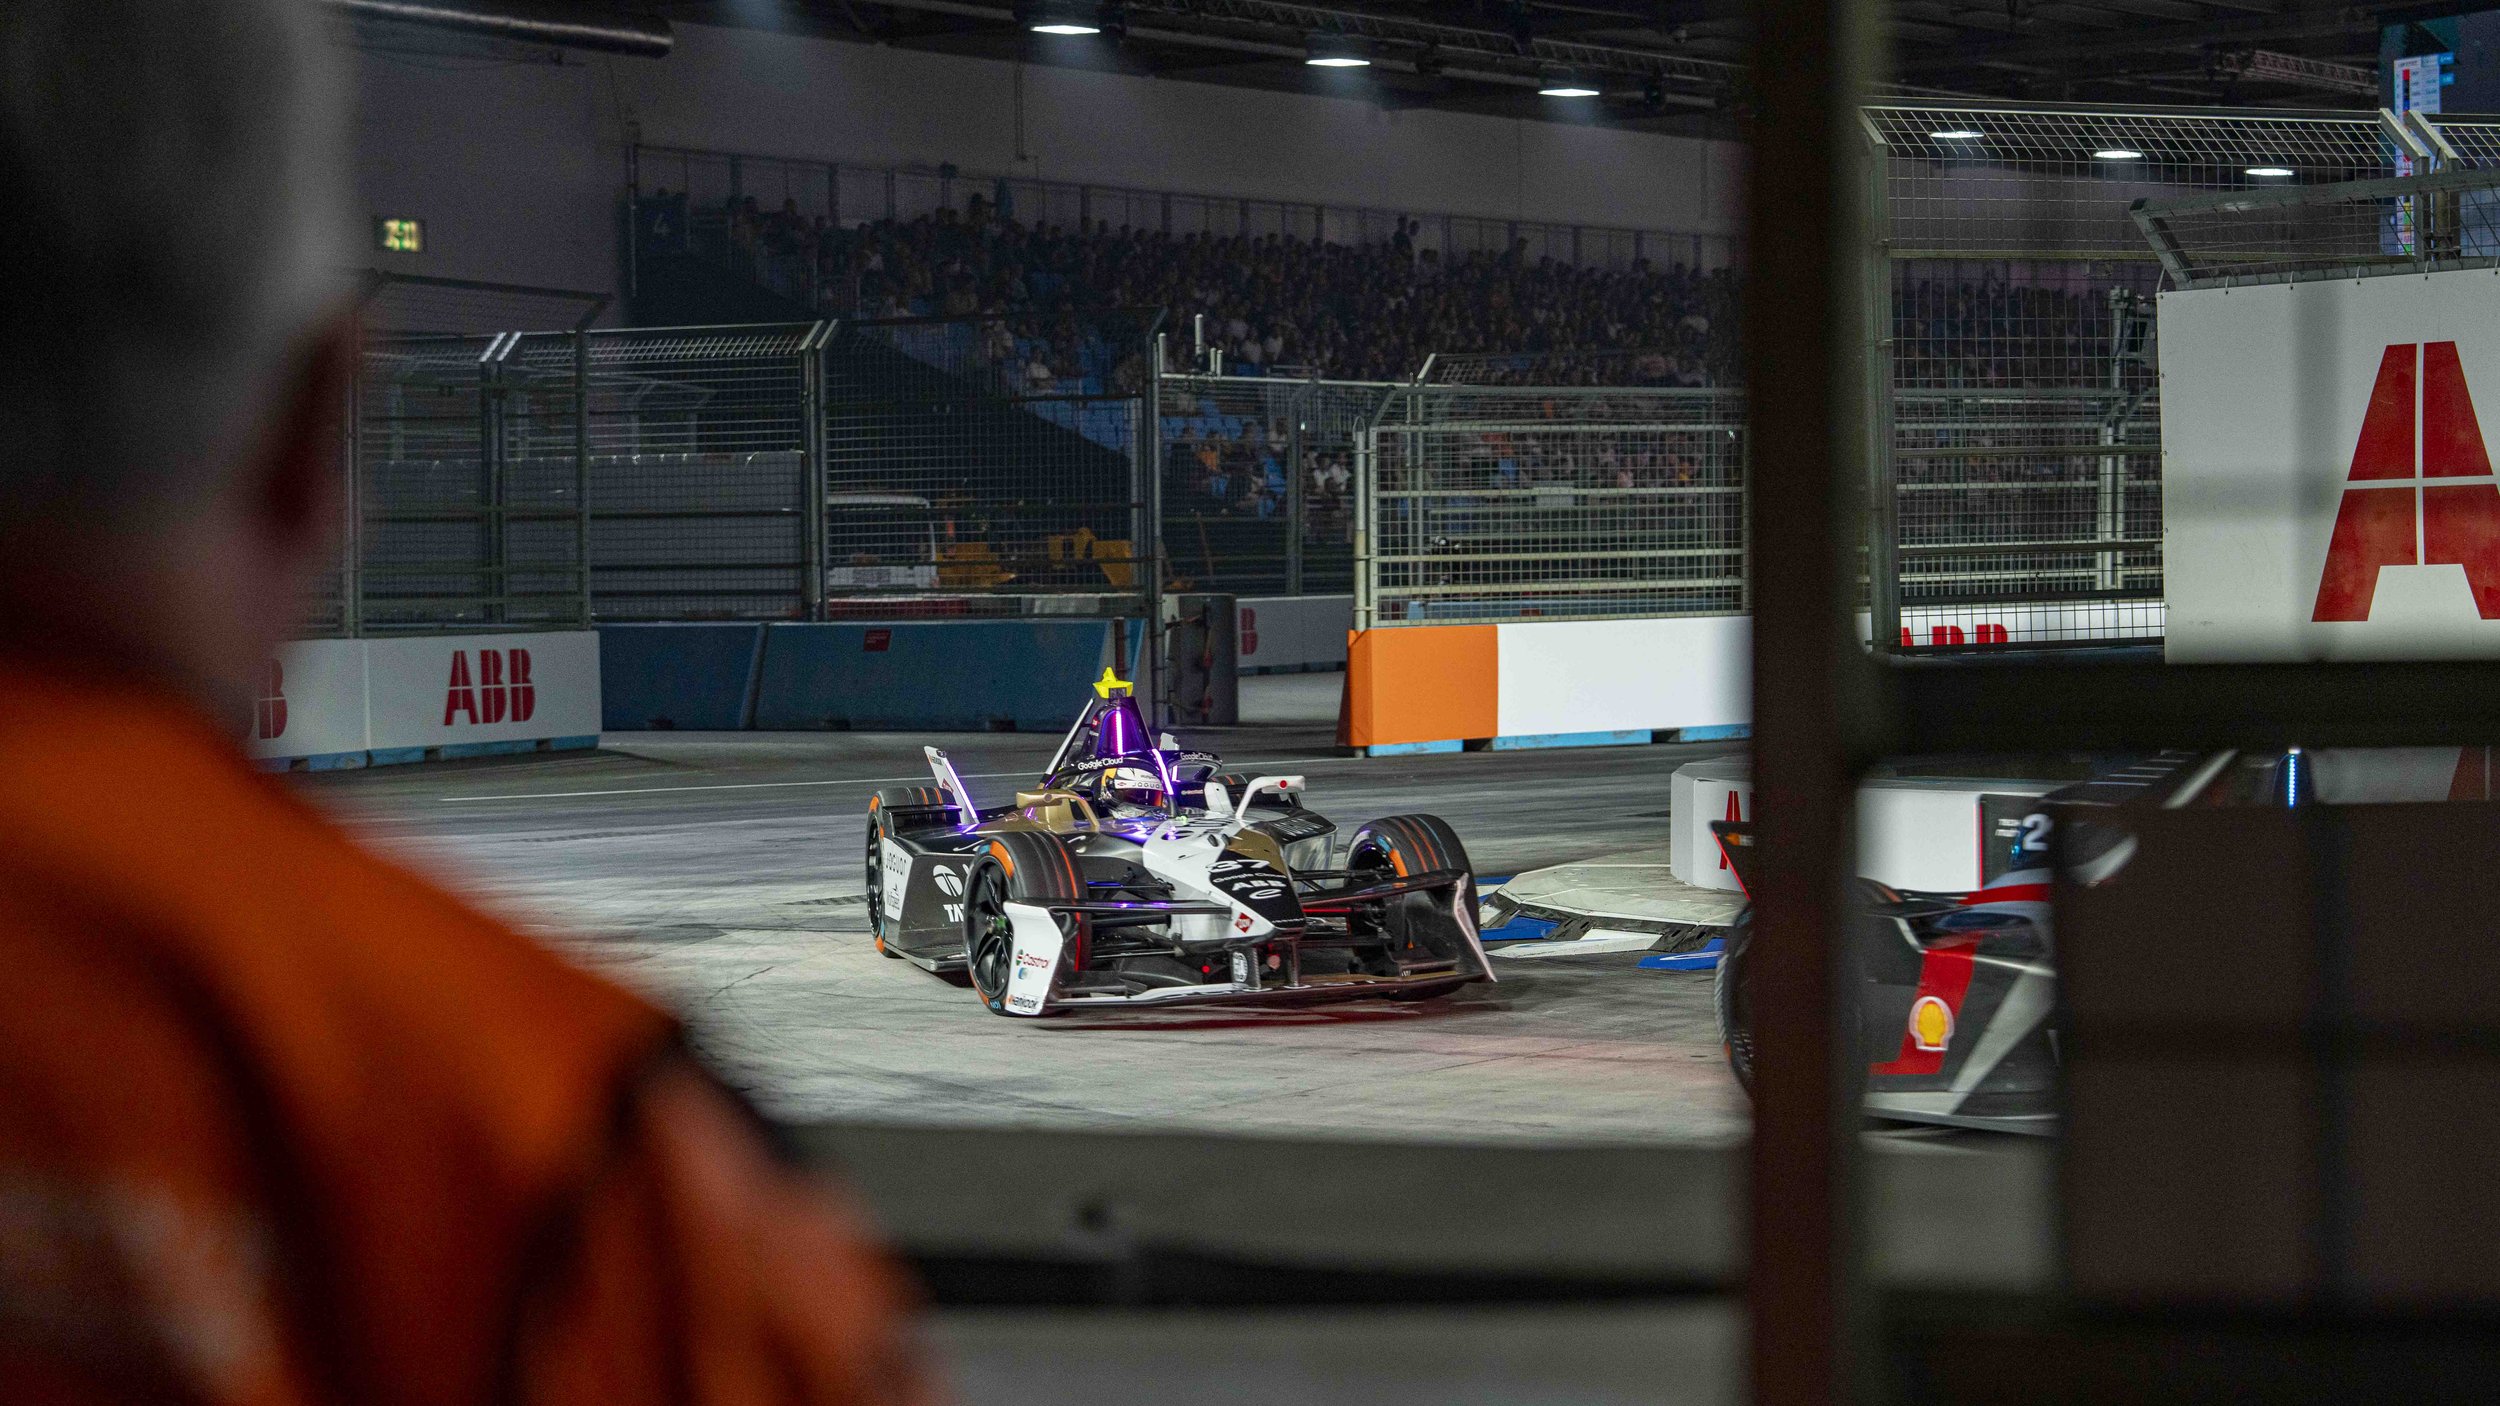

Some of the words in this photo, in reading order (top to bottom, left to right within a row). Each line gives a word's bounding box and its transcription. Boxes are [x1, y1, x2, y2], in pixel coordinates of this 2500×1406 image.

[444, 648, 536, 726] ABB
[1078, 759, 1102, 770] Google
[1102, 757, 1124, 767] Cloud
[1206, 859, 1270, 873] 37
[1232, 880, 1287, 891] ABB
[1023, 953, 1049, 968] Castrol
